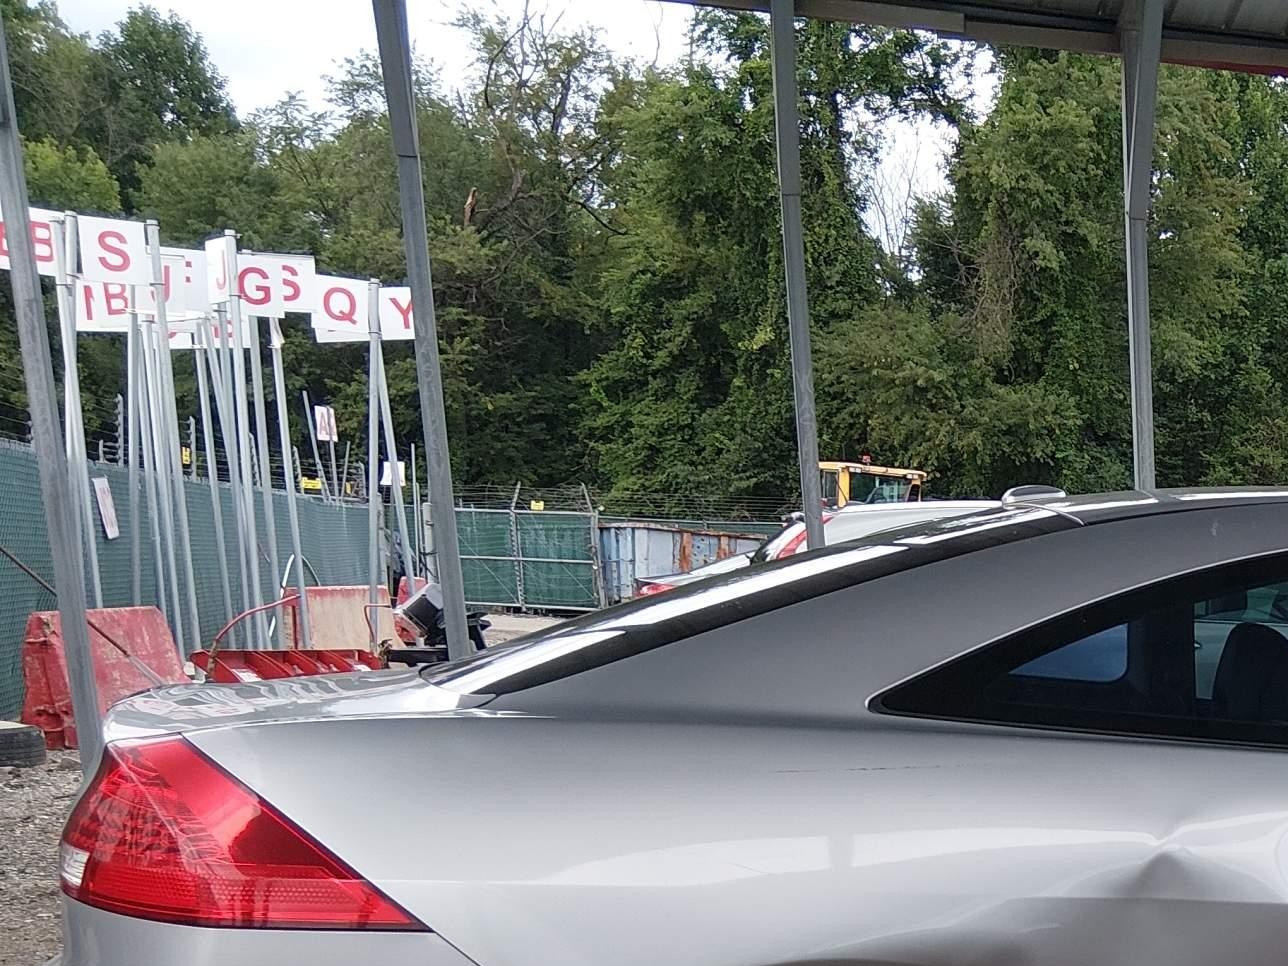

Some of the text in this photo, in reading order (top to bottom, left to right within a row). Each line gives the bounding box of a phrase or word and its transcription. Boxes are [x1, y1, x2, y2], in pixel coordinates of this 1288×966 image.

[98, 230, 131, 272] S
[237, 266, 272, 306] G
[323, 286, 358, 325] Q
[389, 297, 413, 330] Y
